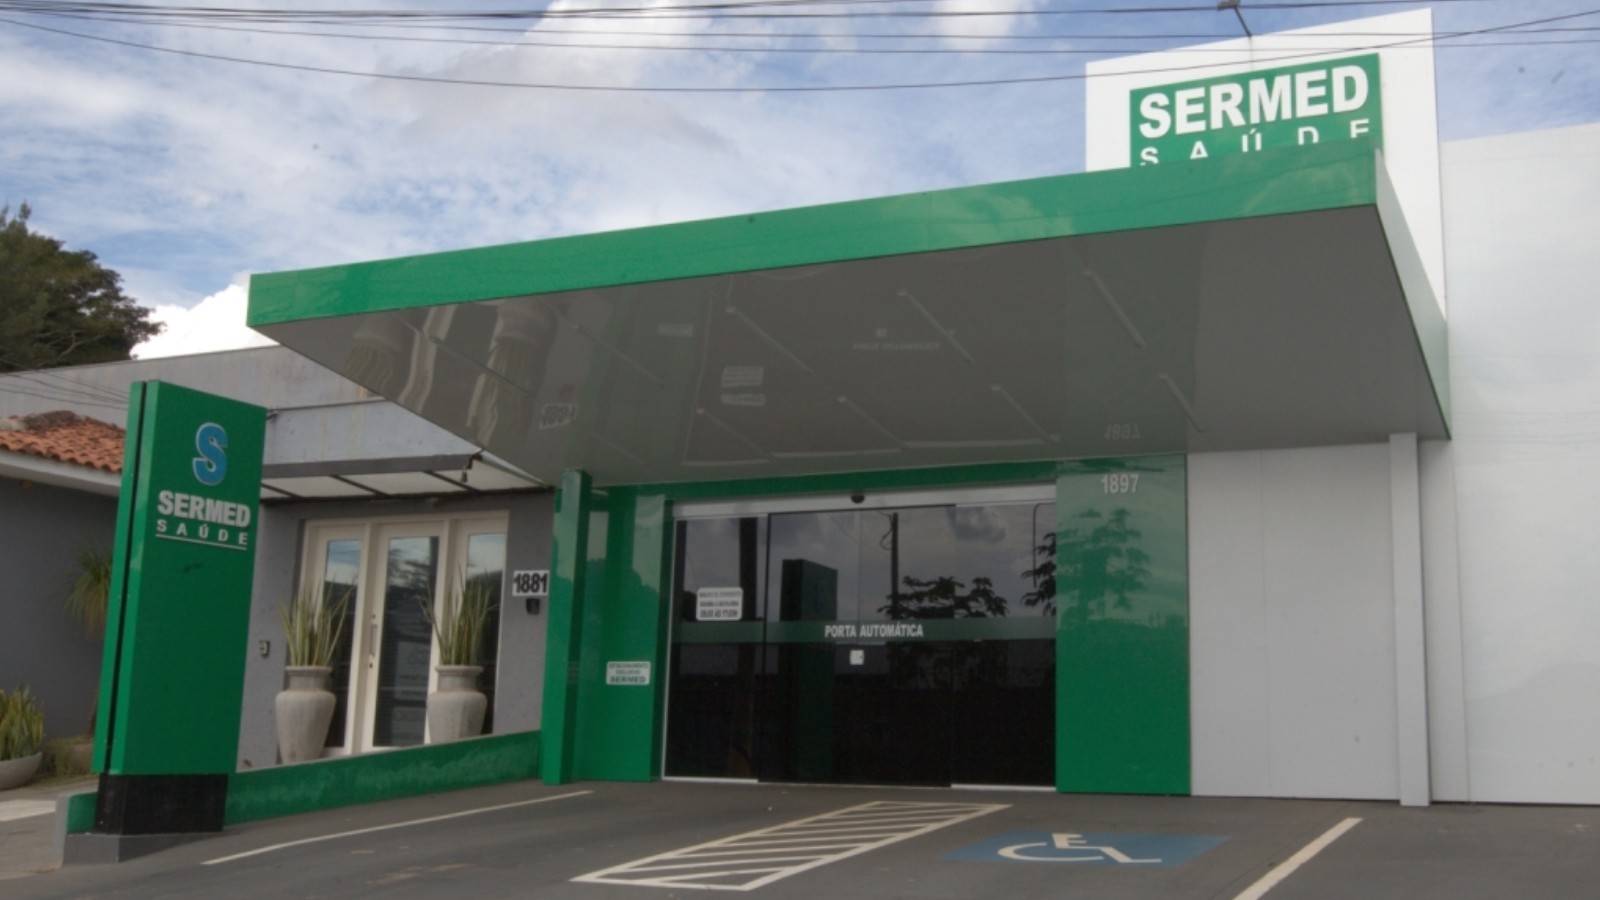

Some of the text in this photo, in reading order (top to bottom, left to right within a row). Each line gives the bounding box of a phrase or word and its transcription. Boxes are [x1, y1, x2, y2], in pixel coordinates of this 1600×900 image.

[1139, 65, 1369, 138] SERMED
[192, 422, 228, 486] S
[1101, 473, 1140, 494] 1897
[157, 490, 251, 528] SERMED
[157, 519, 248, 545] SAÚDE
[513, 572, 548, 594] 1881
[824, 621, 924, 638] PORTA AUTOMÁTICA
